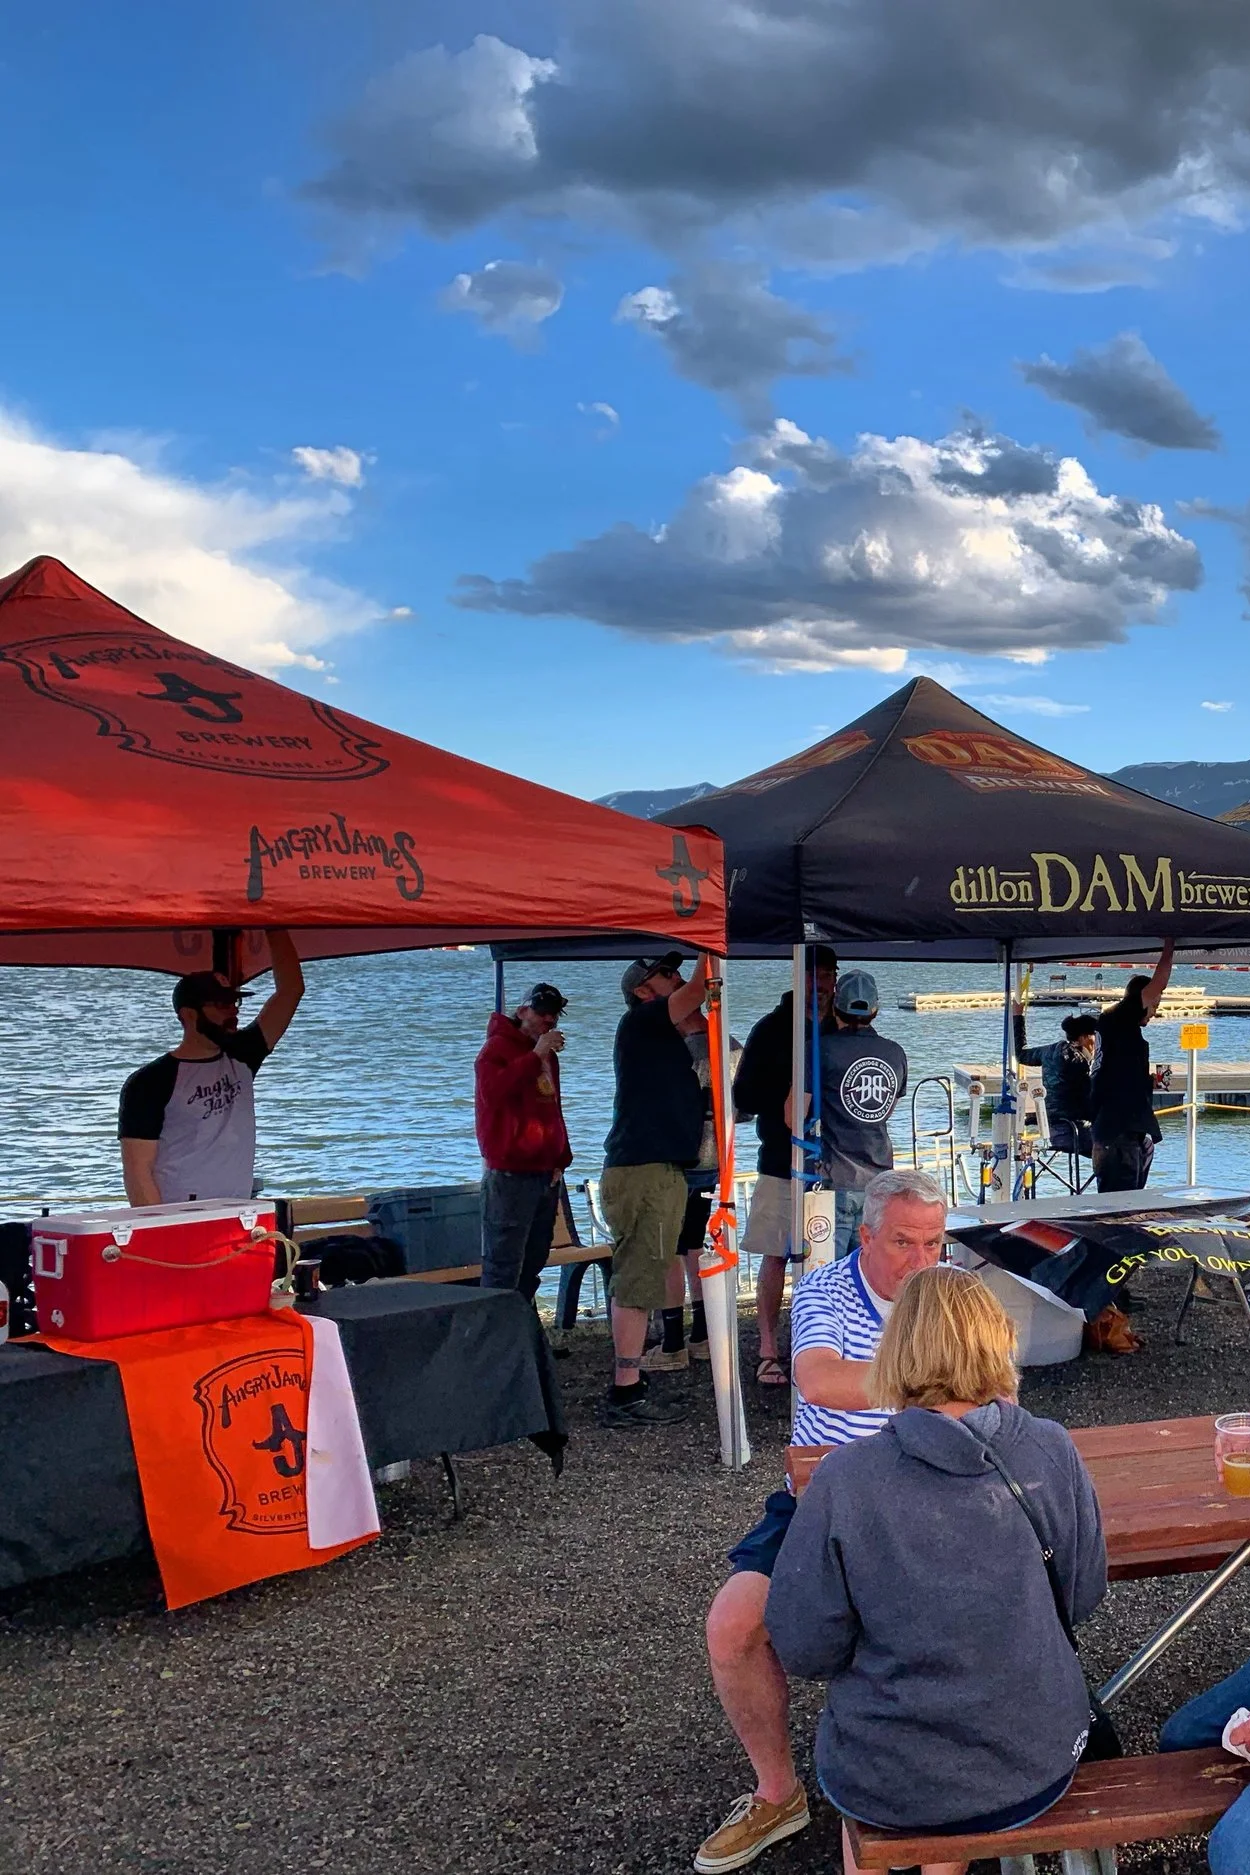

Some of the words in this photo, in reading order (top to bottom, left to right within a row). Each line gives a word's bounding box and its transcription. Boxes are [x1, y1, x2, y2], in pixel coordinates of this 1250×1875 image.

[176, 731, 312, 750] BREWERY
[964, 776, 1111, 796] BREWERY
[299, 865, 376, 880] BREWERY
[950, 866, 1034, 903] dillon
[1031, 853, 1175, 912] DAM
[1106, 1254, 1148, 1284] GET
